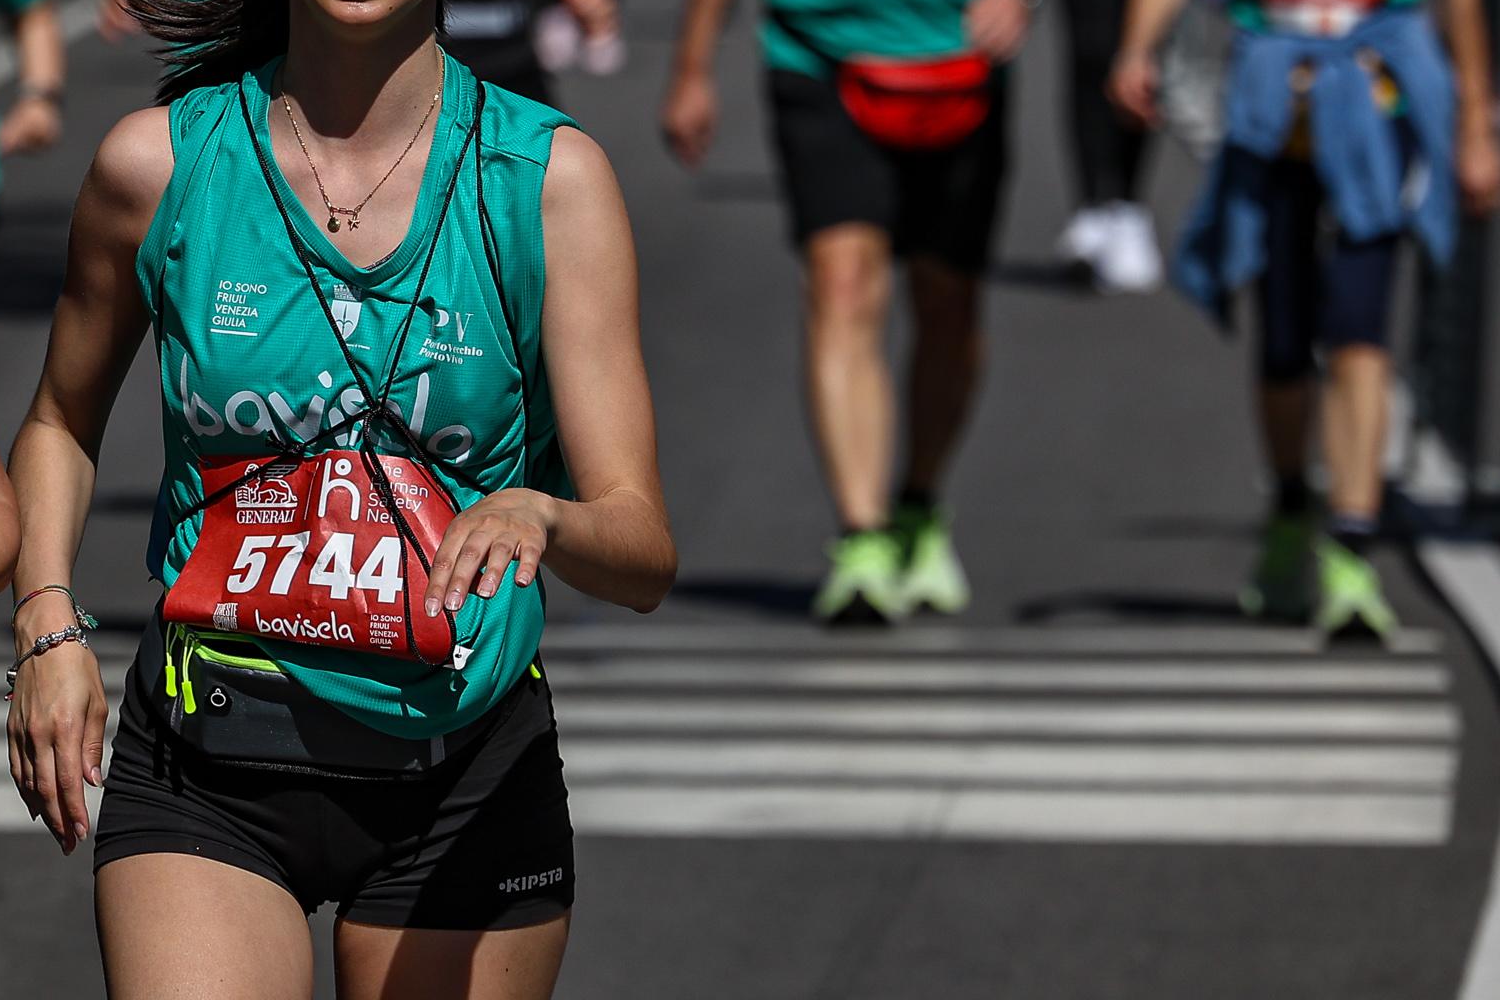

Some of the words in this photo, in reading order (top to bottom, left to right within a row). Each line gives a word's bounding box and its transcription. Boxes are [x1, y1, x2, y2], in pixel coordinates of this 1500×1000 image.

[219, 280, 232, 290] IO
[234, 282, 267, 295] SONO
[216, 292, 246, 304] FRIULI
[215, 303, 259, 318] VENEZIA
[212, 315, 246, 328] GIULIA
[236, 509, 296, 524] GENERALI
[226, 530, 404, 604] 5744
[255, 608, 355, 643] bavisela
[380, 615, 402, 623] SONO
[369, 622, 390, 630] FRIULI
[369, 630, 399, 638] VENEZIA
[369, 637, 393, 645] GIULIA
